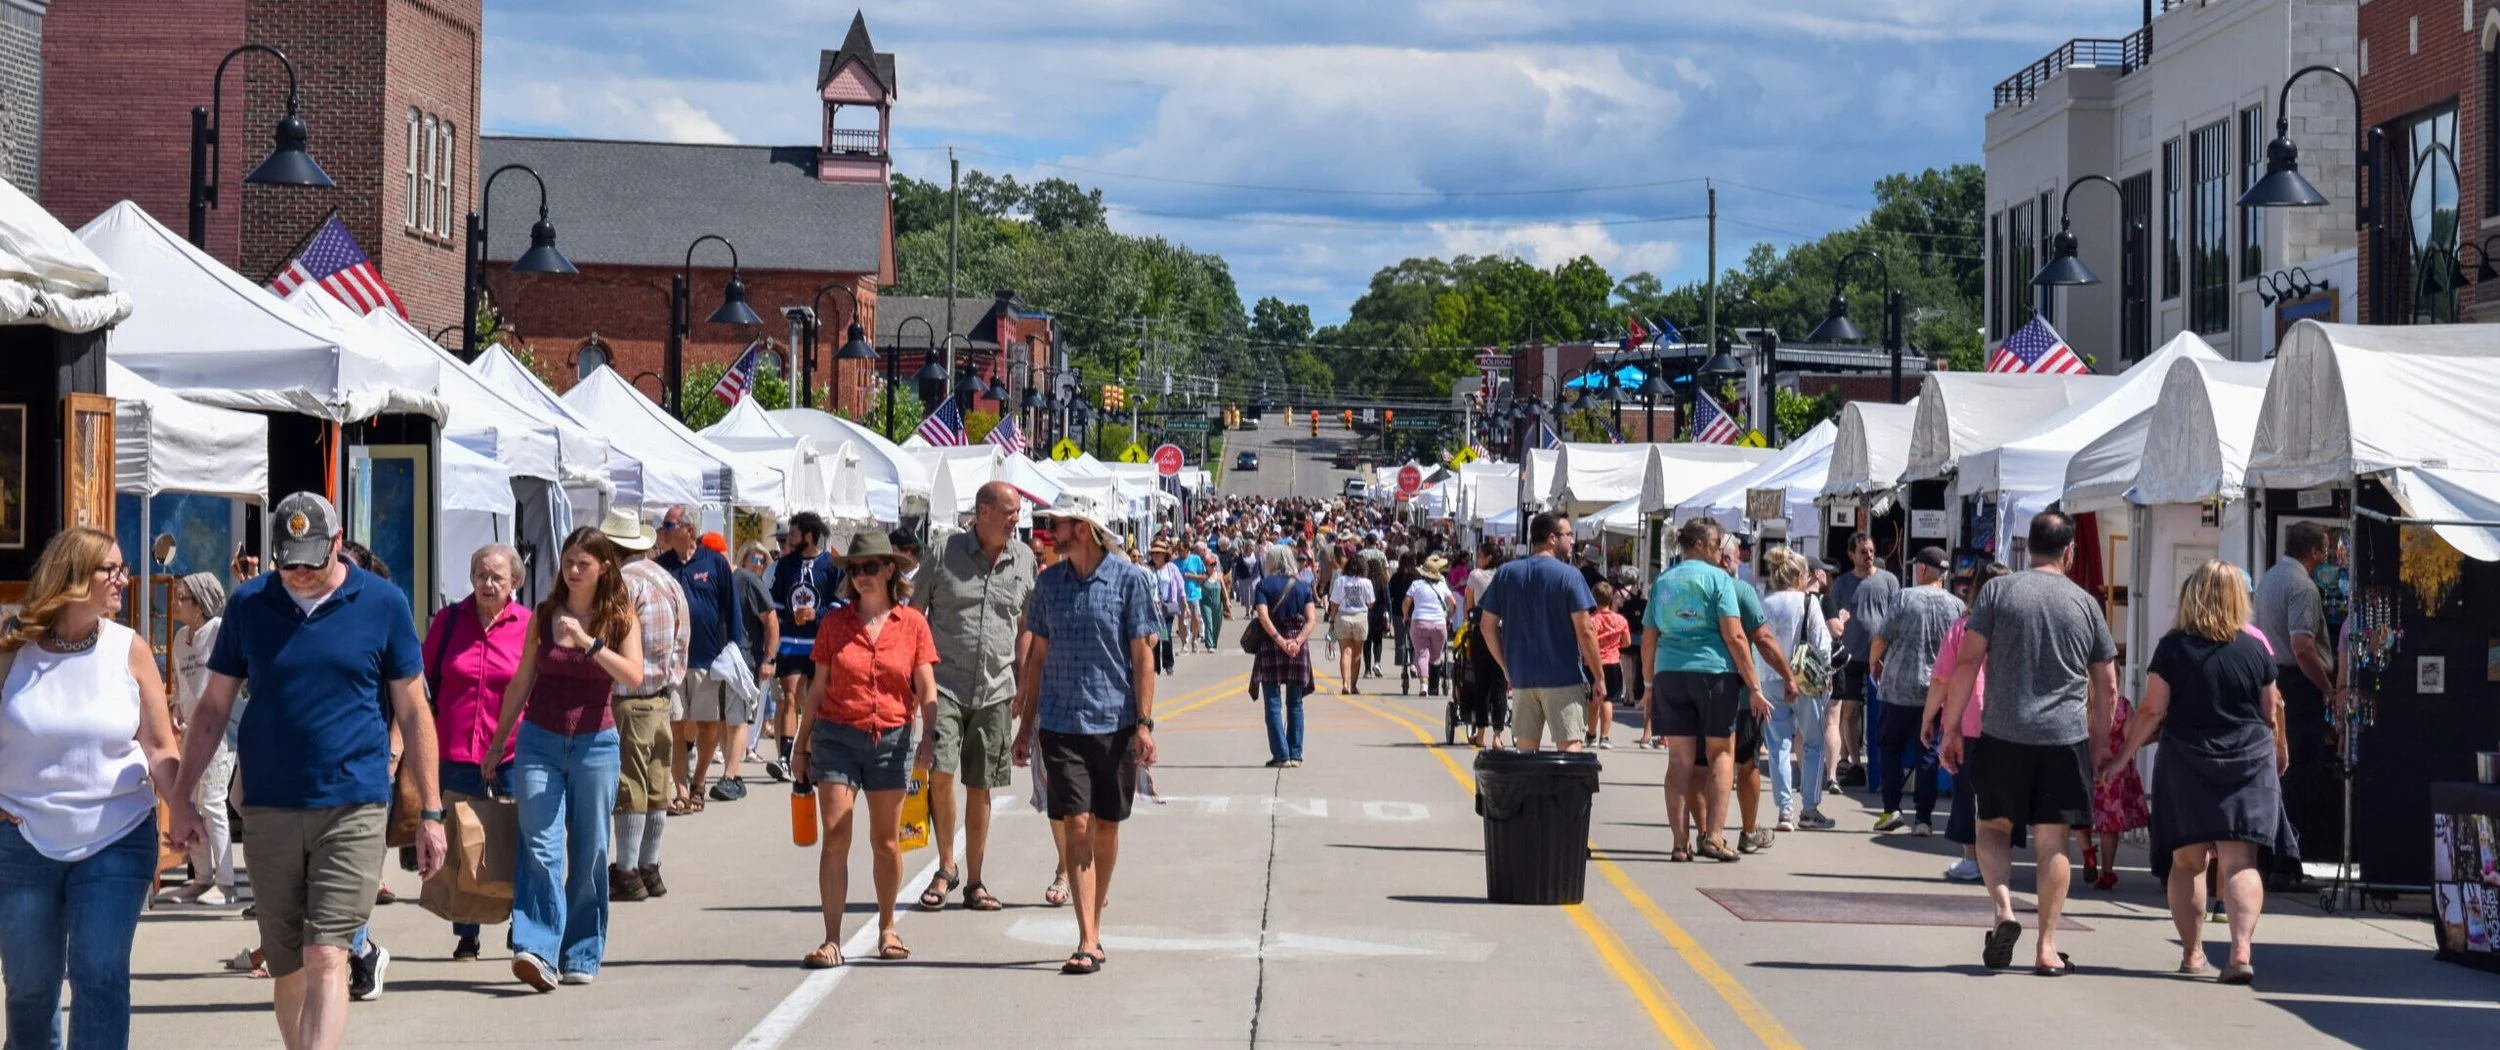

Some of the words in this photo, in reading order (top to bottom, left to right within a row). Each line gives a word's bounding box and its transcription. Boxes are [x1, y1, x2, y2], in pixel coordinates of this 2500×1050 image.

[2481, 889, 2498, 905] FUEL
[2483, 904, 2499, 920] FOR
[2486, 920, 2500, 933] MO
